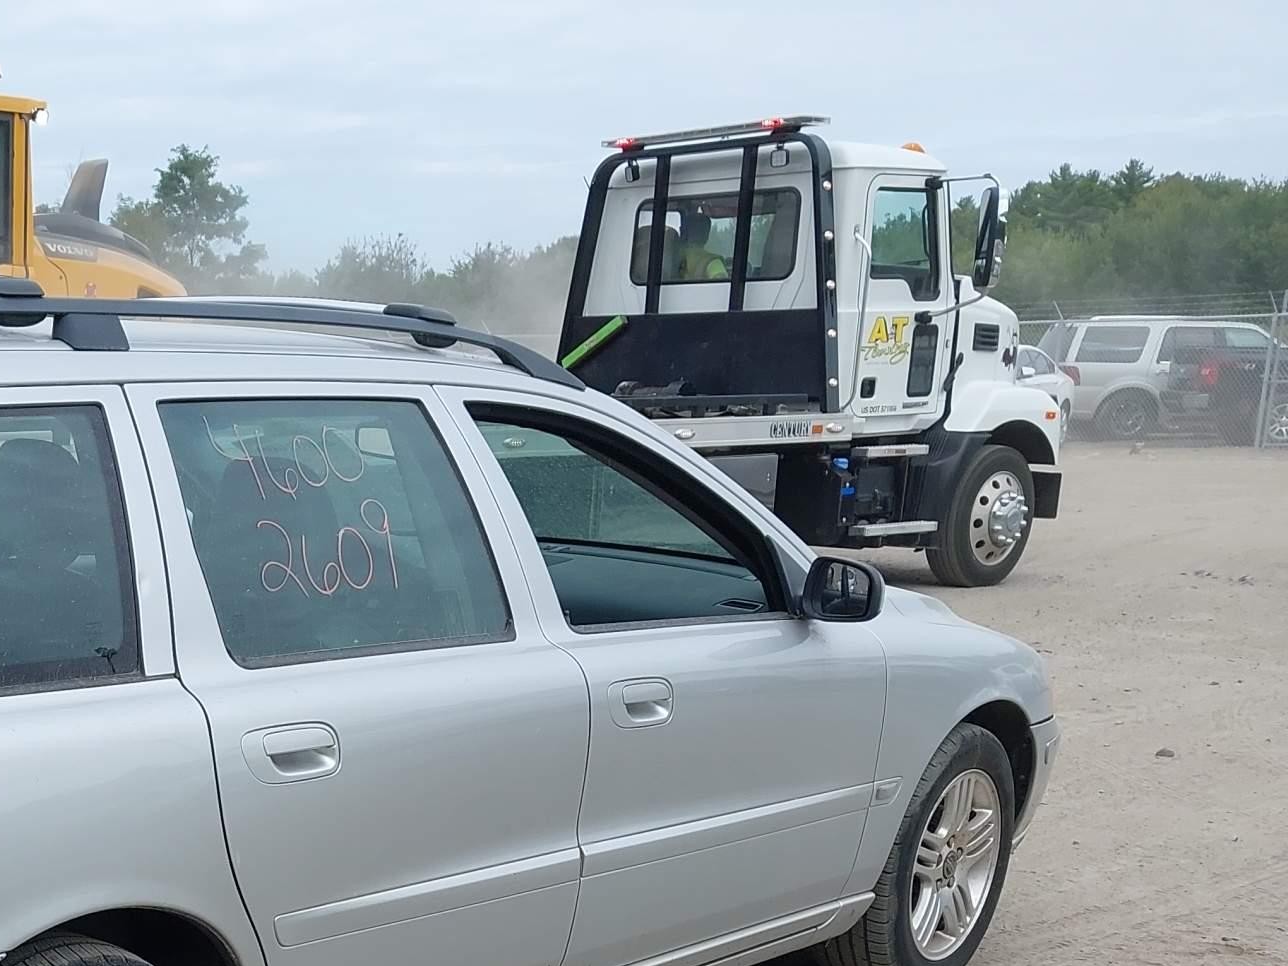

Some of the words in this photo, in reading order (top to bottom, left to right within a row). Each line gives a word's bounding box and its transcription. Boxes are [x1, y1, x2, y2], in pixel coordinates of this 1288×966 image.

[45, 243, 94, 256] VOLVO
[869, 405, 881, 413] DOT
[769, 421, 811, 438] CENTURY
[257, 499, 398, 598] 2609
